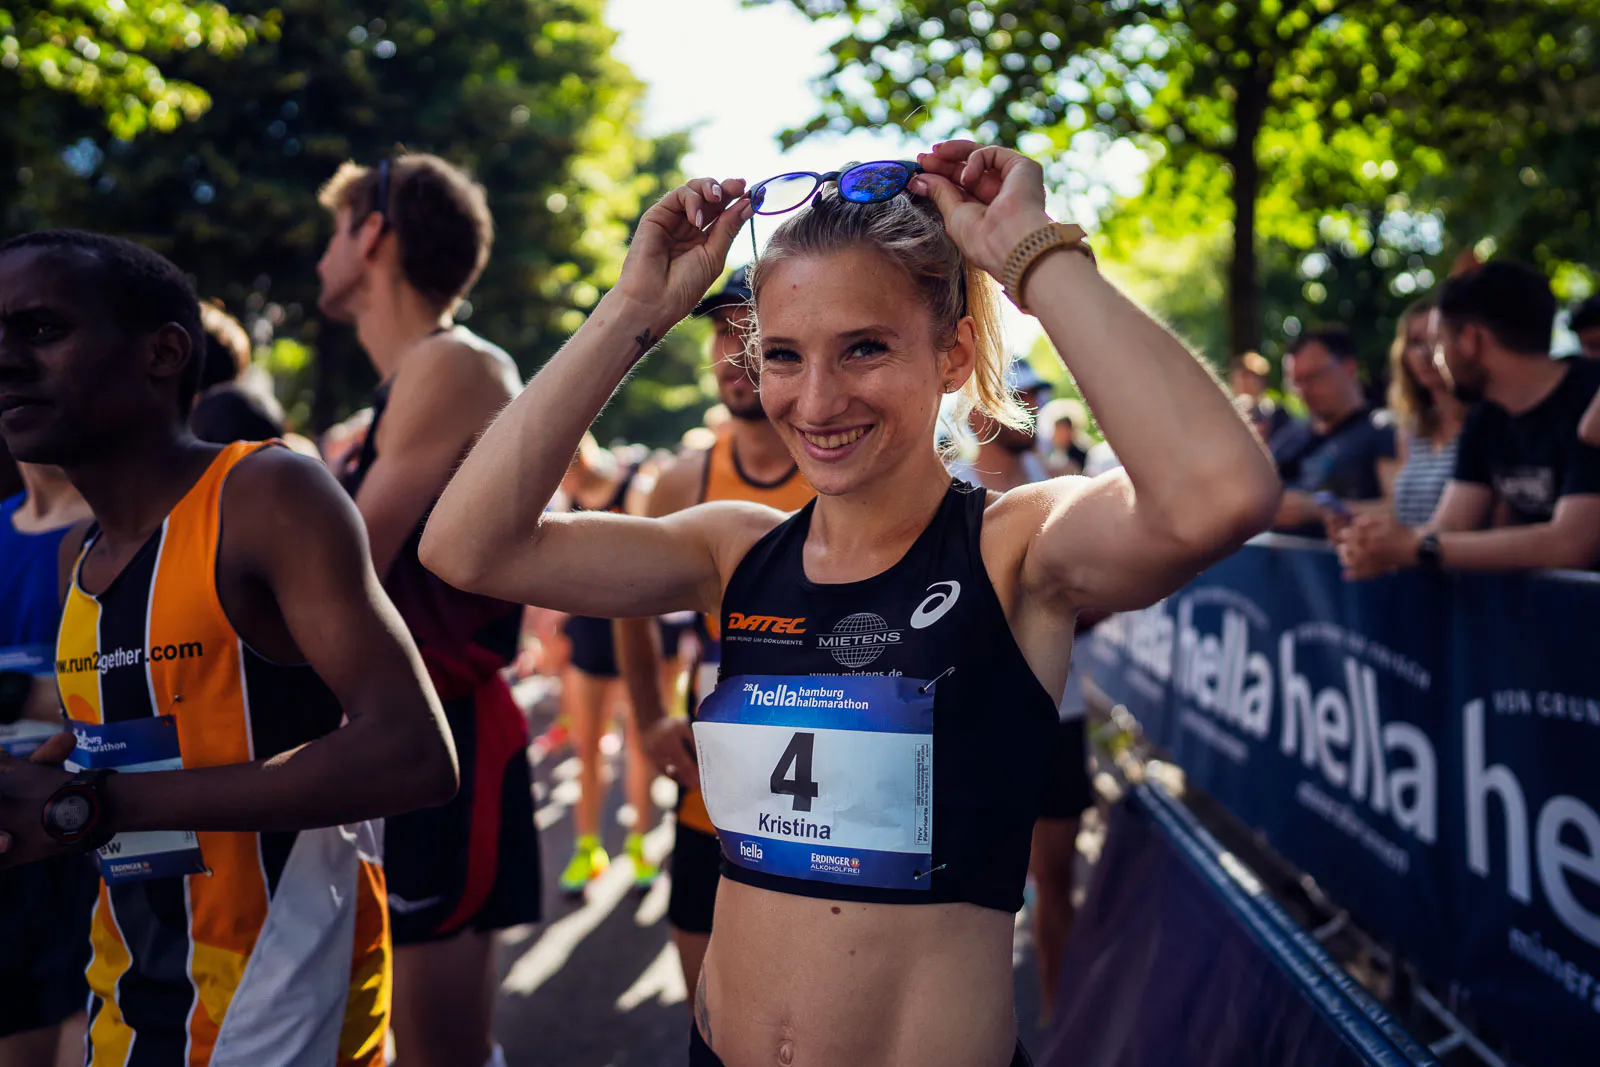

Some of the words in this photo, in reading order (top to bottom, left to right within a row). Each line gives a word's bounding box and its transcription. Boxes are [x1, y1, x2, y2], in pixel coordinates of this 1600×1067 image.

[728, 612, 806, 634] DATEC
[763, 638, 803, 646] DOKUMENTE
[818, 632, 901, 647] MIETENS
[750, 684, 797, 707] hella
[798, 686, 844, 700] hamburg
[796, 698, 869, 710] halbmarathon
[1279, 628, 1438, 845] hella
[770, 732, 819, 812] 4
[758, 812, 831, 840] Kristina
[740, 841, 763, 860] hella
[811, 853, 850, 867] ERDINGER
[811, 864, 860, 874] ALKOHOLFREI
